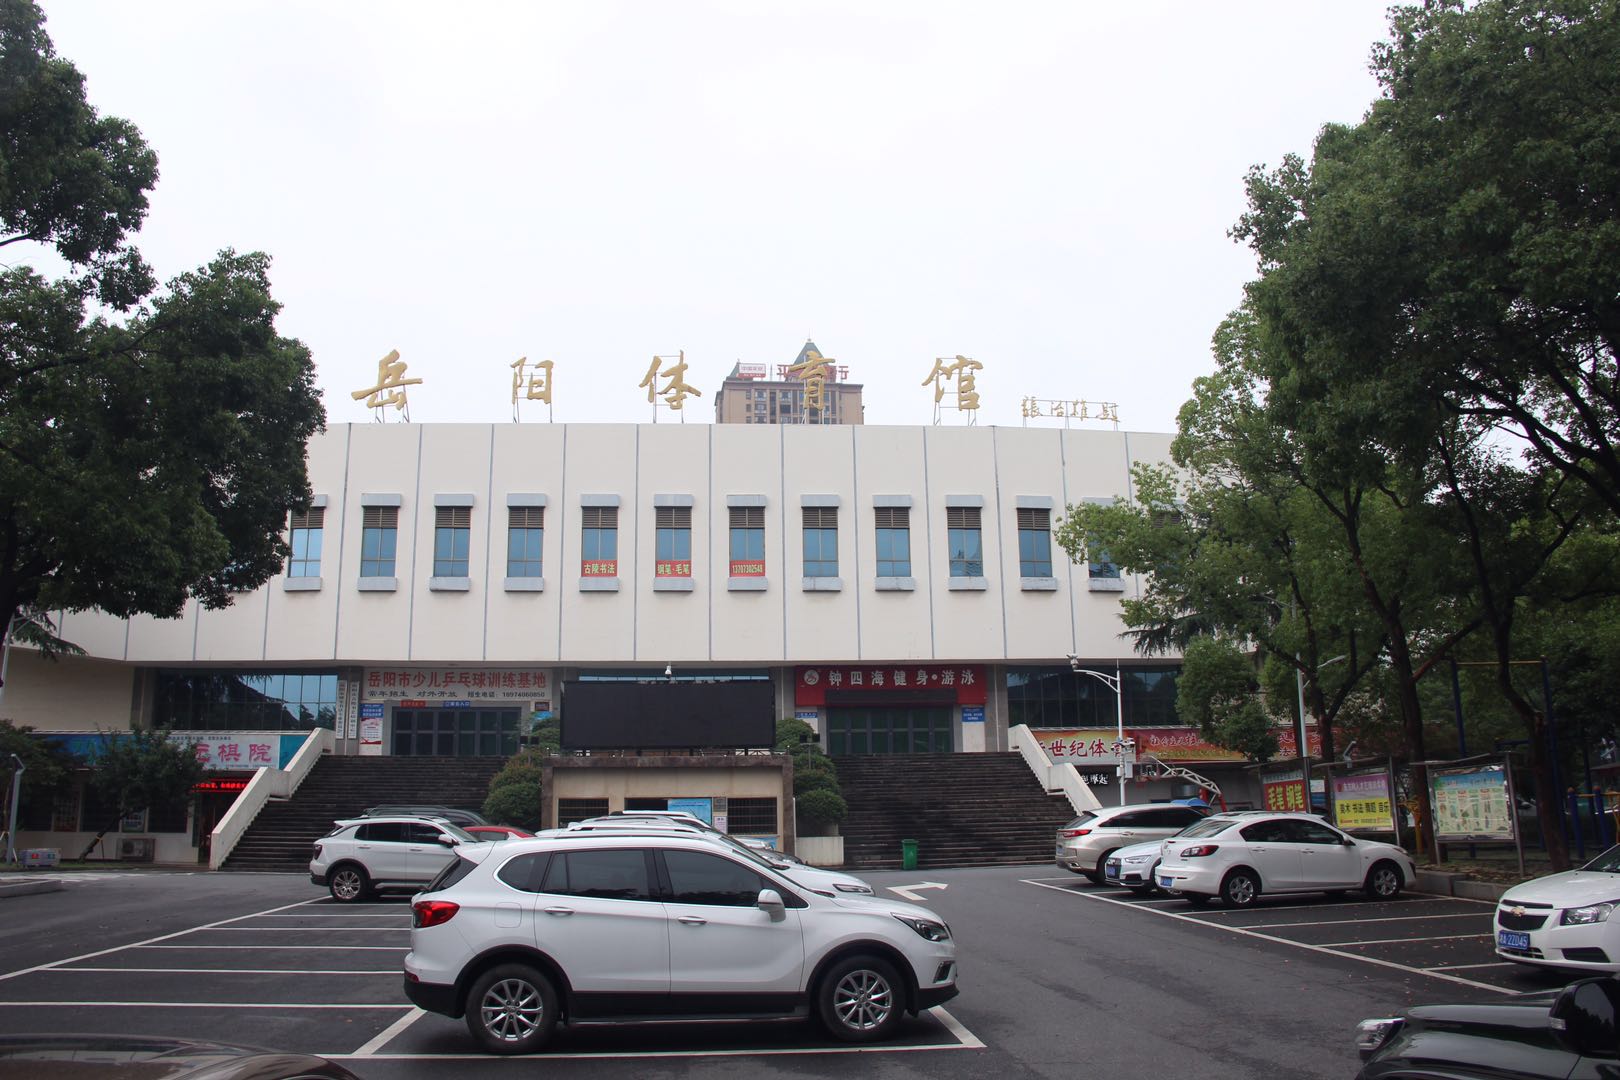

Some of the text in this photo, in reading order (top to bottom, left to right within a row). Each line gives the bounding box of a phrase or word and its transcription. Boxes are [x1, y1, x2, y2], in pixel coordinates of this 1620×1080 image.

[351, 348, 983, 411] 岳阳体育馆
[368, 671, 547, 688] 岳阳市少儿乒乓球训练基地
